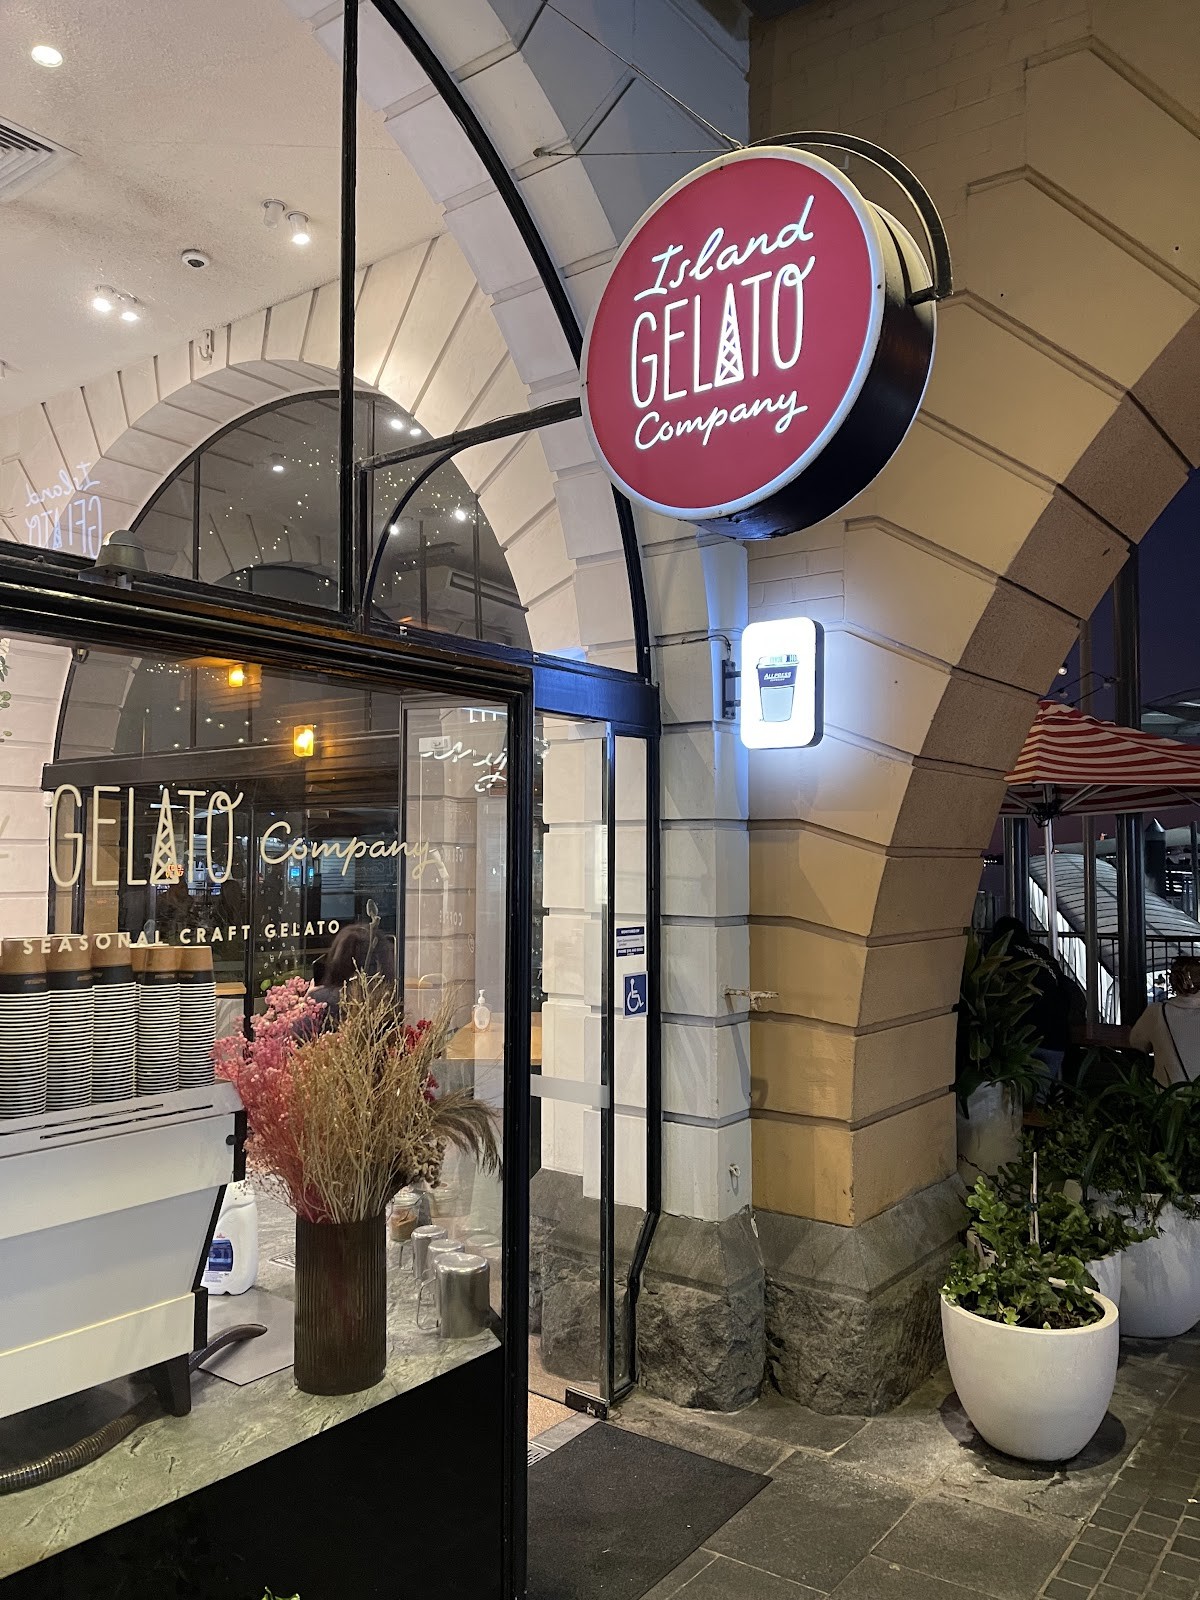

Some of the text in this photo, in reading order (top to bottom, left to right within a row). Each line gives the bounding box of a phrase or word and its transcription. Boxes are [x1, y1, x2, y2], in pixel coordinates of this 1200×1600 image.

[634, 194, 815, 301] Island
[631, 255, 816, 409] GELATO
[634, 390, 808, 451] Company
[49, 783, 438, 888] GELATO Company
[22, 919, 341, 955] SEASONAL CRAFT GELATO
